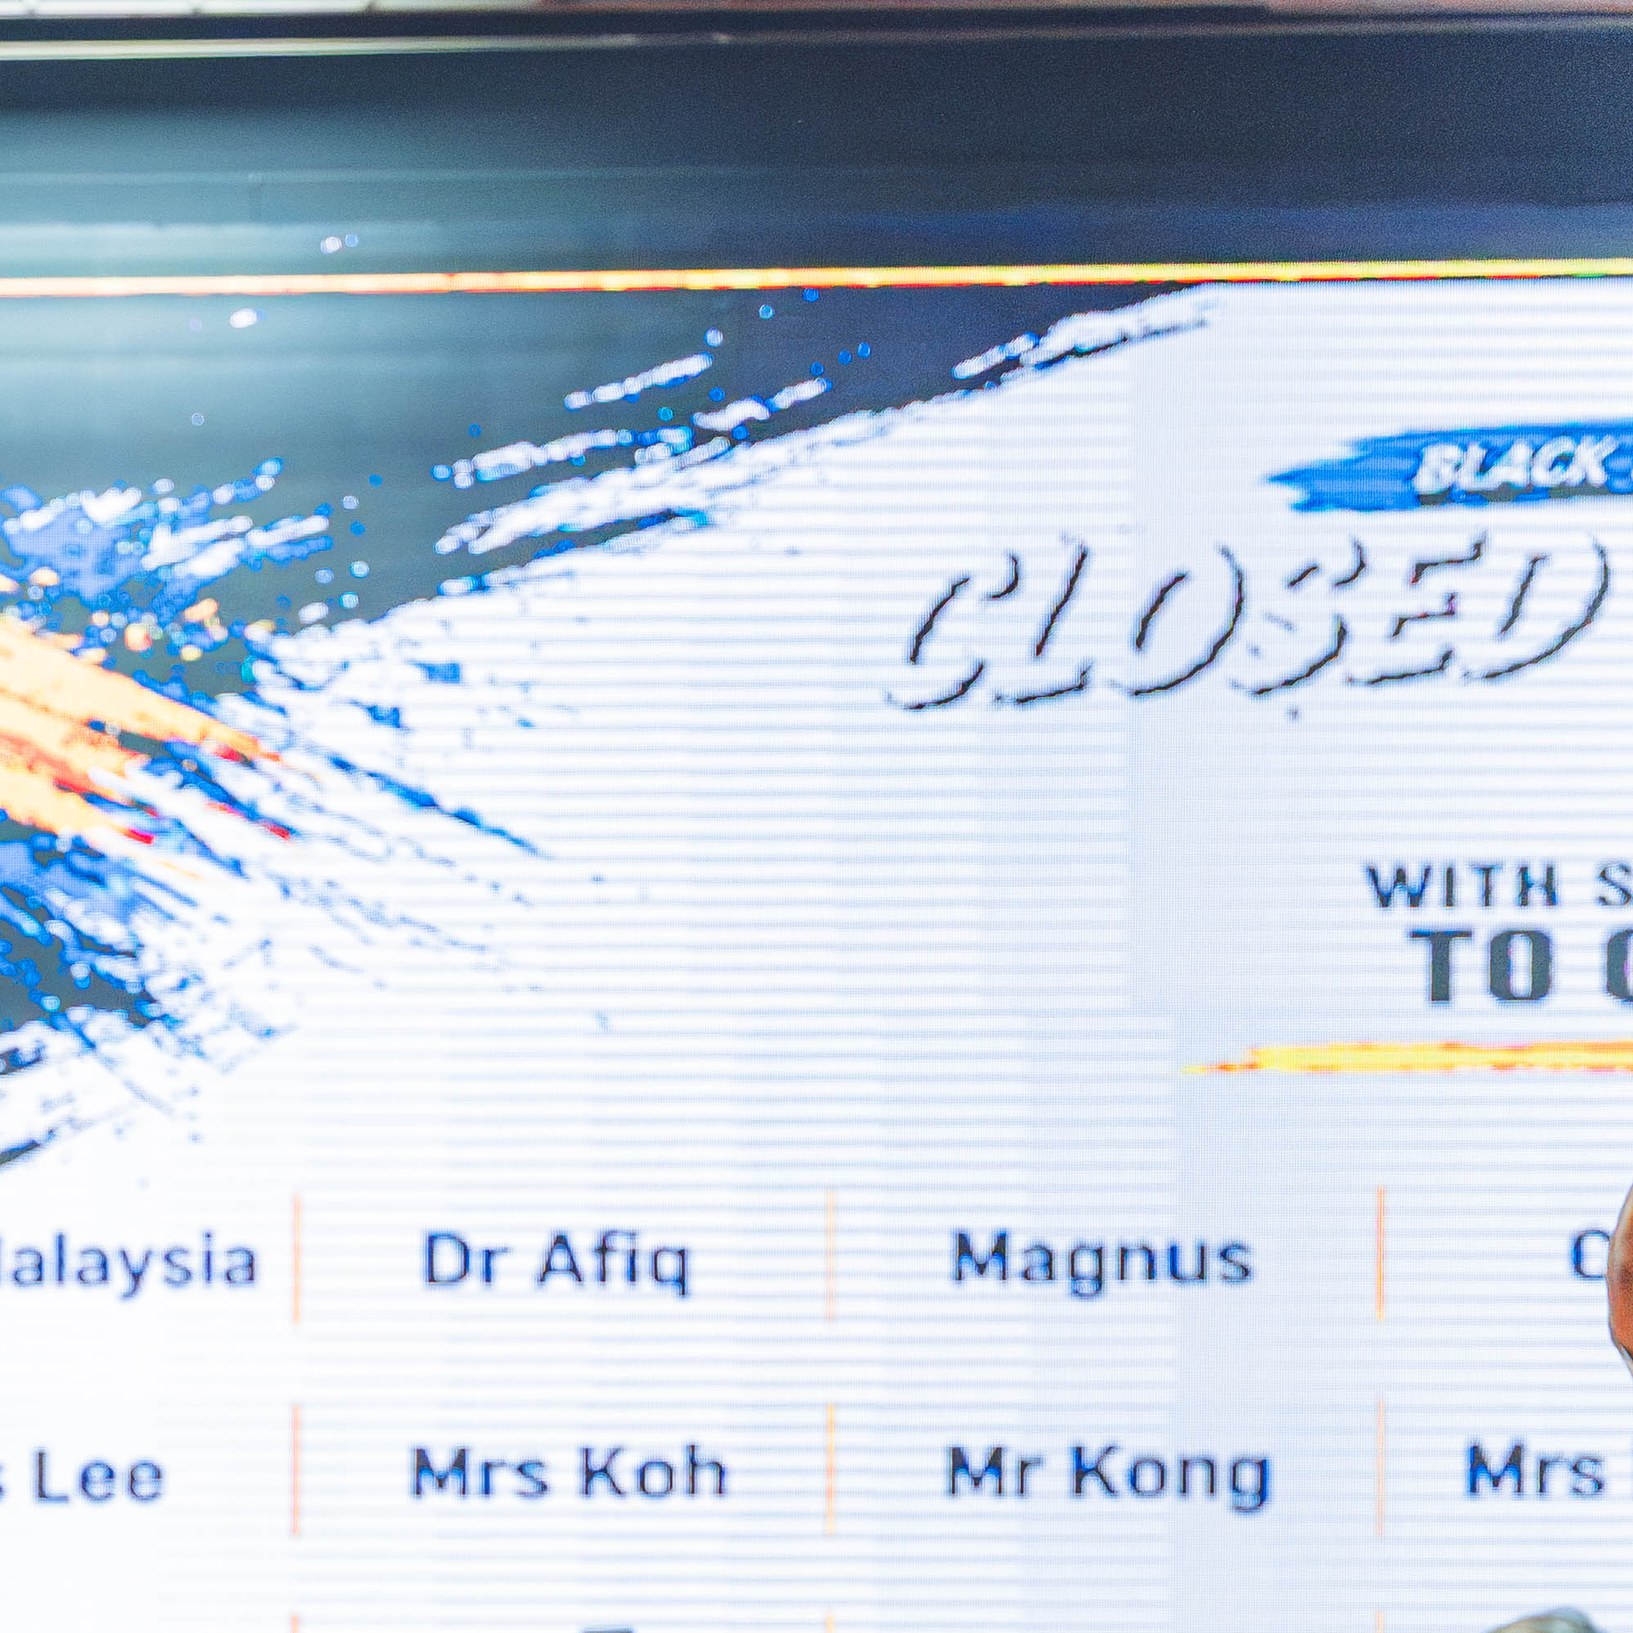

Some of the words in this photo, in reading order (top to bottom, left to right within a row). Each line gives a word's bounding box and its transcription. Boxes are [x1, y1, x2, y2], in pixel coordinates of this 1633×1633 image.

[1413, 436, 1617, 493] BLACK
[884, 532, 1609, 710] CLOSED
[1366, 865, 1558, 908] WITH
[1410, 929, 1555, 1002] TO
[424, 1231, 508, 1287] Dr
[539, 1229, 692, 1298] Afiq
[952, 1229, 1254, 1298] Magnus
[34, 1448, 164, 1502] Lee
[410, 1445, 547, 1499] Mrs
[578, 1443, 728, 1498] Koh
[945, 1445, 1041, 1498] Mr
[1069, 1444, 1272, 1512] Kong
[1465, 1441, 1606, 1497] Mrs
